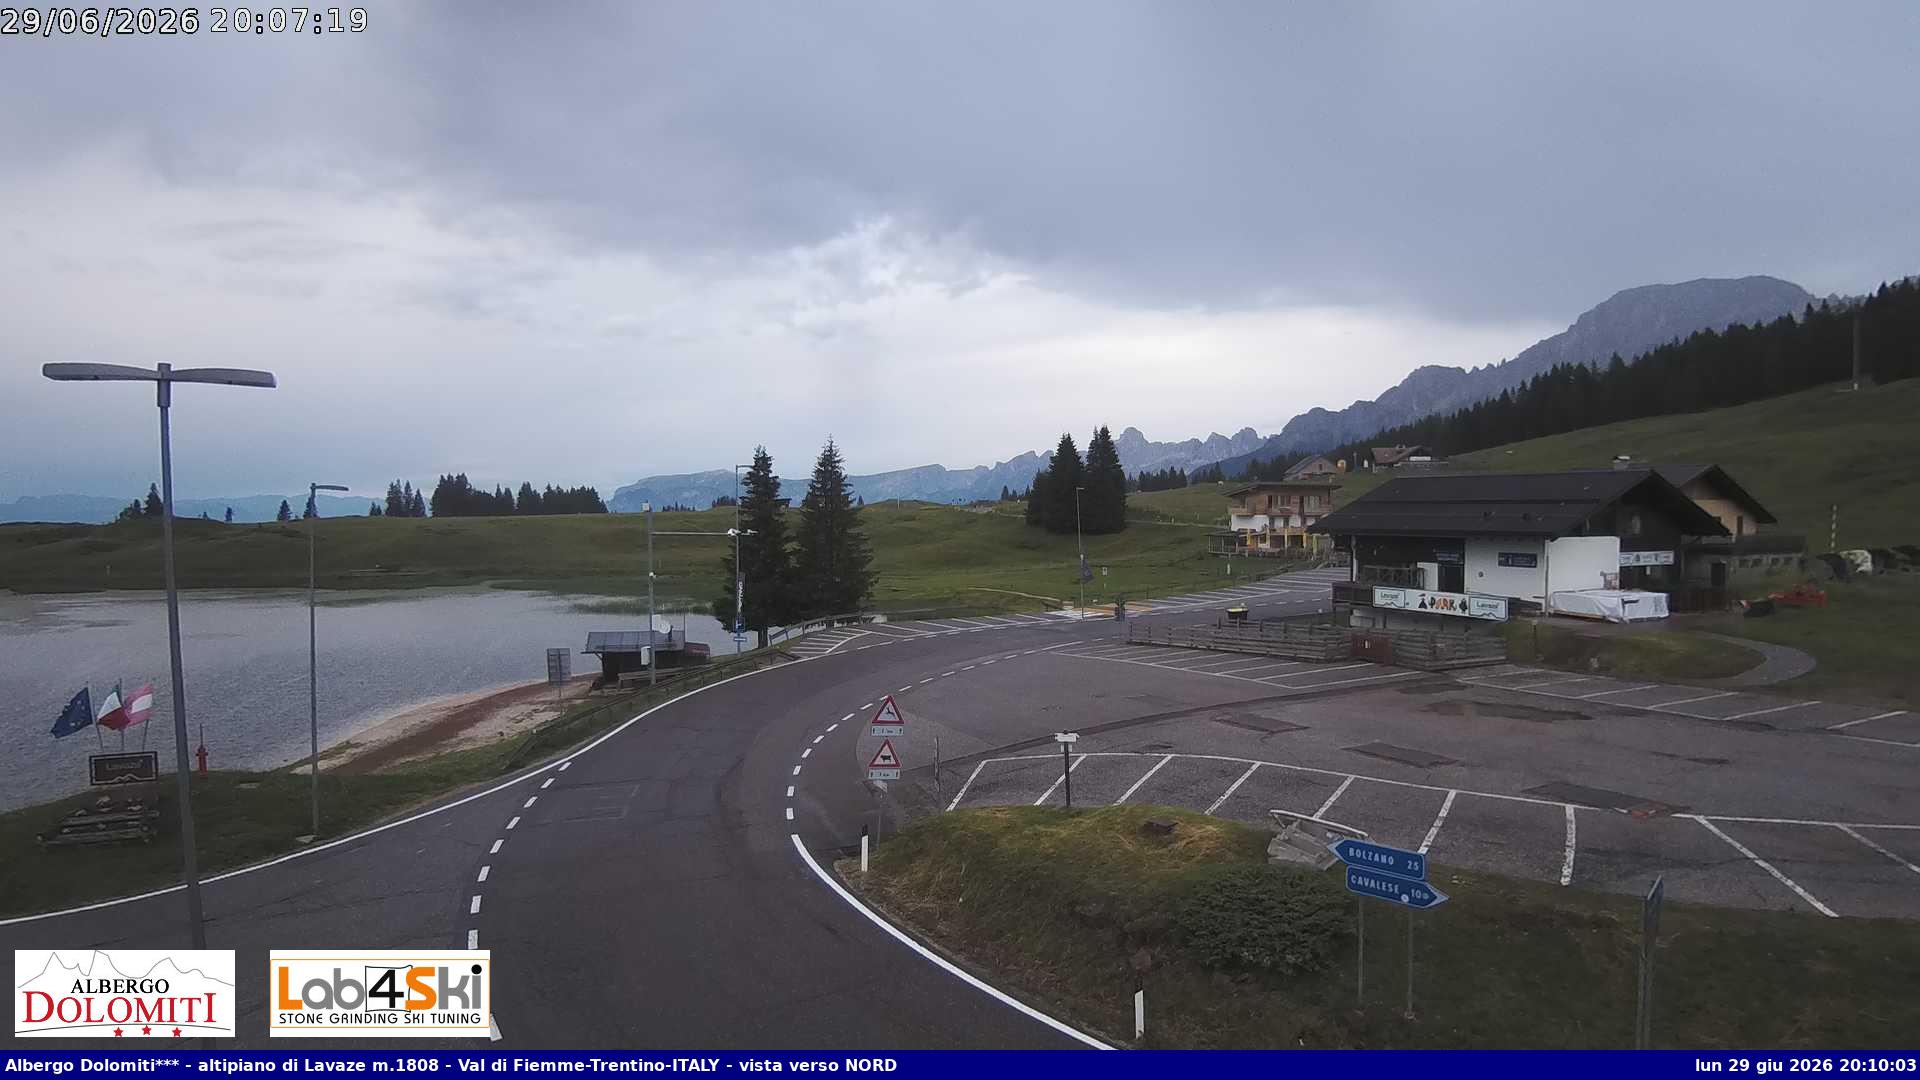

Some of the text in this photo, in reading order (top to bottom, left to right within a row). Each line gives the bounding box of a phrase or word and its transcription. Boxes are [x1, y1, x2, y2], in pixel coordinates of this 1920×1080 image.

[1348, 847, 1420, 871] BOLZANO 25
[1350, 874, 1421, 898] CAVALESE 10
